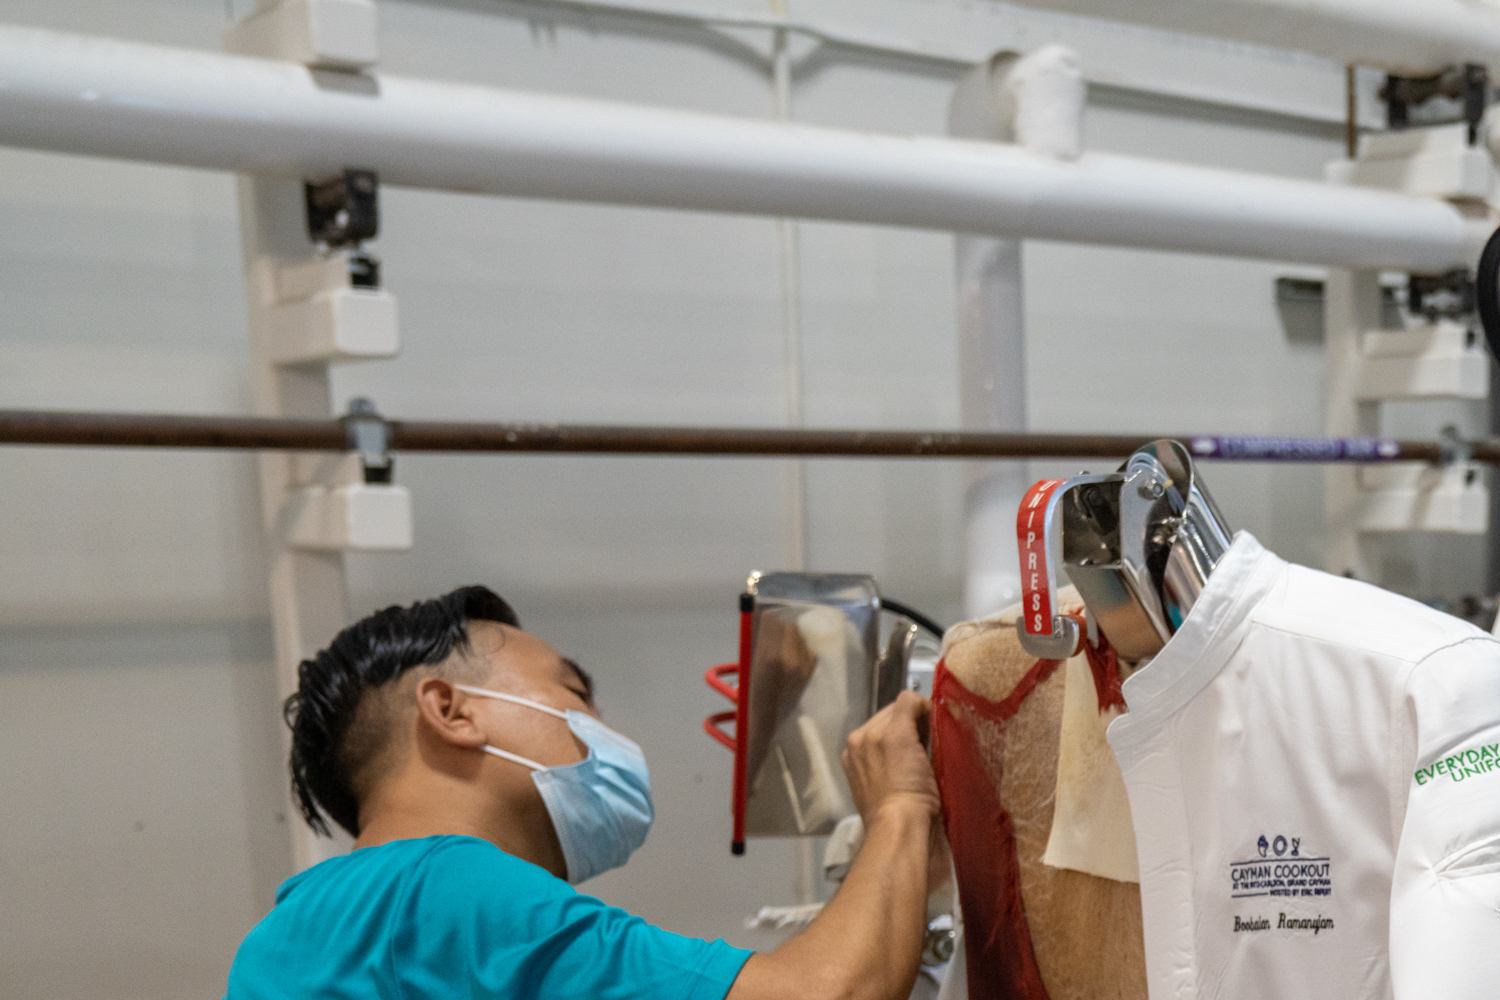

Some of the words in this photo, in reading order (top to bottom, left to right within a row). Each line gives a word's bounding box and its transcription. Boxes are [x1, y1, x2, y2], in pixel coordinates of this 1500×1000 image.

[1027, 480, 1057, 632] UNIPRESS
[1414, 743, 1499, 786] EVERYDAY
[1231, 866, 1271, 882] CAYMAN
[1274, 864, 1330, 878] COOKOUT
